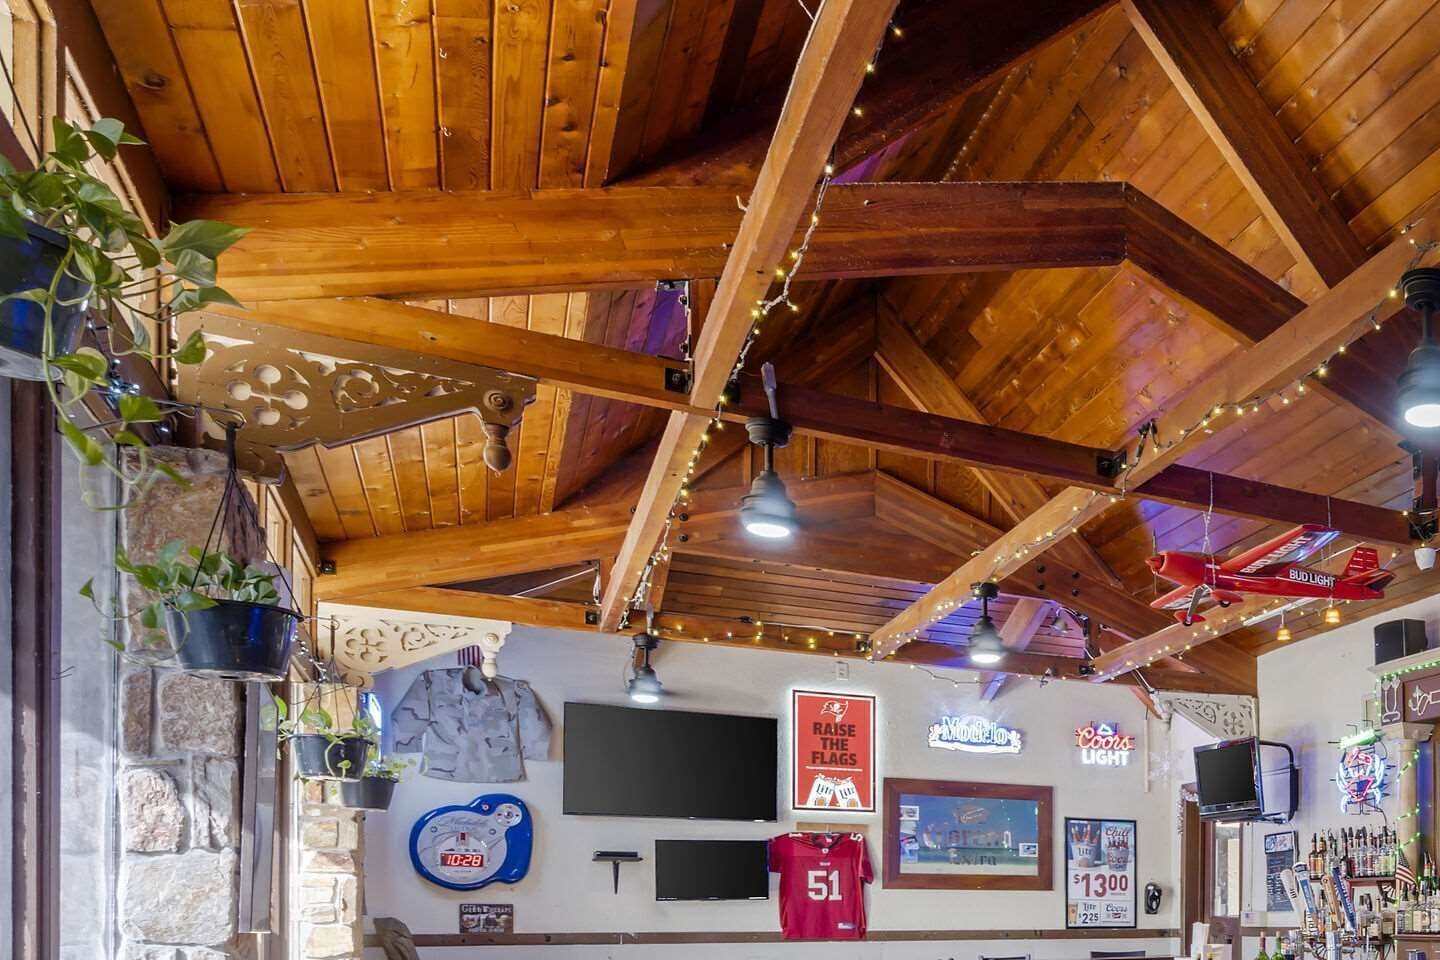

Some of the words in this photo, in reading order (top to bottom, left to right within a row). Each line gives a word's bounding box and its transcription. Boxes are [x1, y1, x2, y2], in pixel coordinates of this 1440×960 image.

[1241, 556, 1271, 574] BUD
[1270, 536, 1313, 563] LIGHT
[1289, 569, 1310, 582] BUD
[1310, 573, 1335, 588] LIGHT
[813, 722, 856, 737] RAISE
[820, 737, 848, 751] THE
[1077, 728, 1131, 749] Coors
[812, 751, 856, 766] FLAGS
[1081, 749, 1129, 766] LIGHT
[447, 854, 482, 867] 10:28
[808, 870, 842, 901] 51
